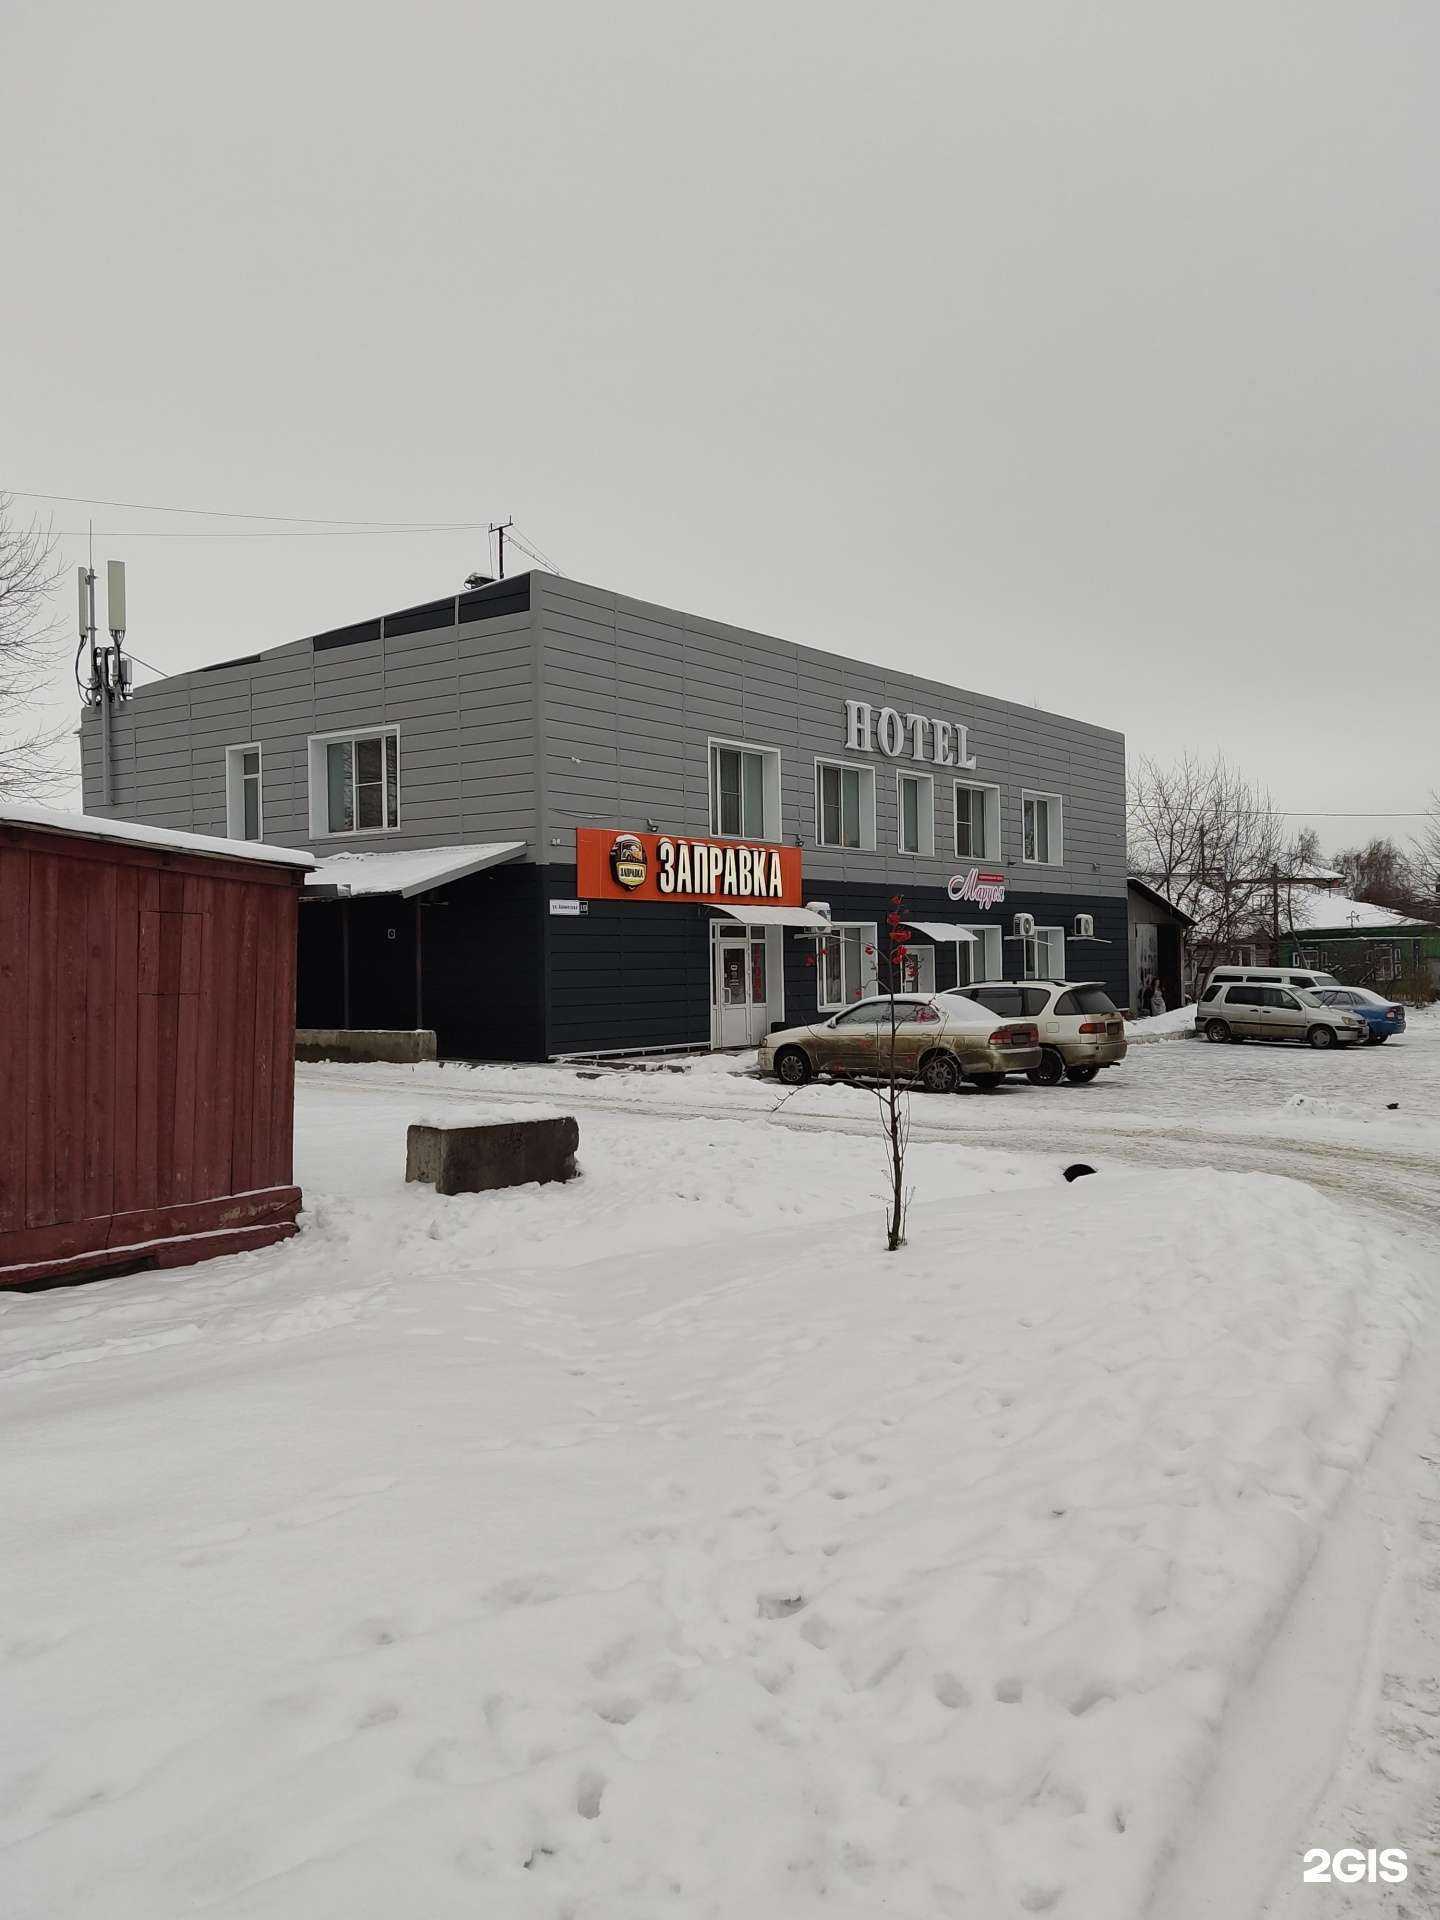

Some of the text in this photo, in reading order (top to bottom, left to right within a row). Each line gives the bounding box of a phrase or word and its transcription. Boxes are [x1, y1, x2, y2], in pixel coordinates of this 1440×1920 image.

[845, 700, 977, 770] HOTEL
[657, 841, 783, 898] ЗАПРАВКА
[948, 867, 1005, 910] Маруся
